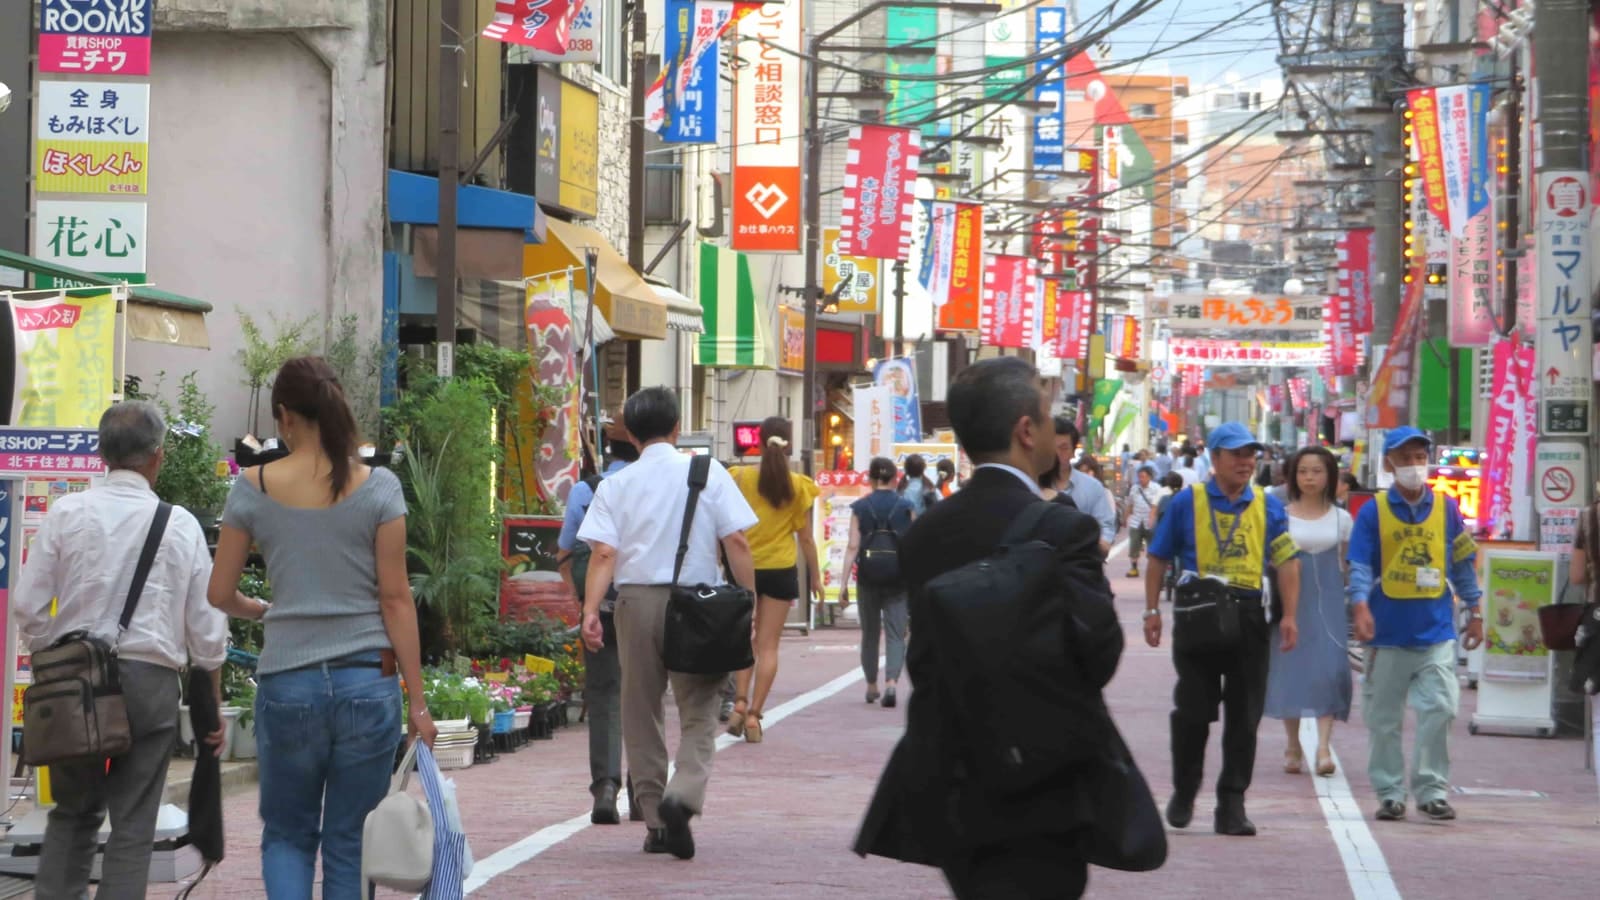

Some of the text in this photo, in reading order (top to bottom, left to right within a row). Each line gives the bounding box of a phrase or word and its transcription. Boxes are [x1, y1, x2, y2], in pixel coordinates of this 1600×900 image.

[45, 8, 145, 34] ROOMS
[59, 50, 127, 71] ニチワ
[70, 89, 119, 108] 全身
[48, 115, 139, 135] もみほぐし
[43, 149, 142, 175] ほぐしくん
[47, 216, 136, 258] 花心
[739, 224, 795, 235] お仕事ハウス
[1551, 251, 1582, 351] マルヤ
[7, 455, 102, 470] 北千住営業所
